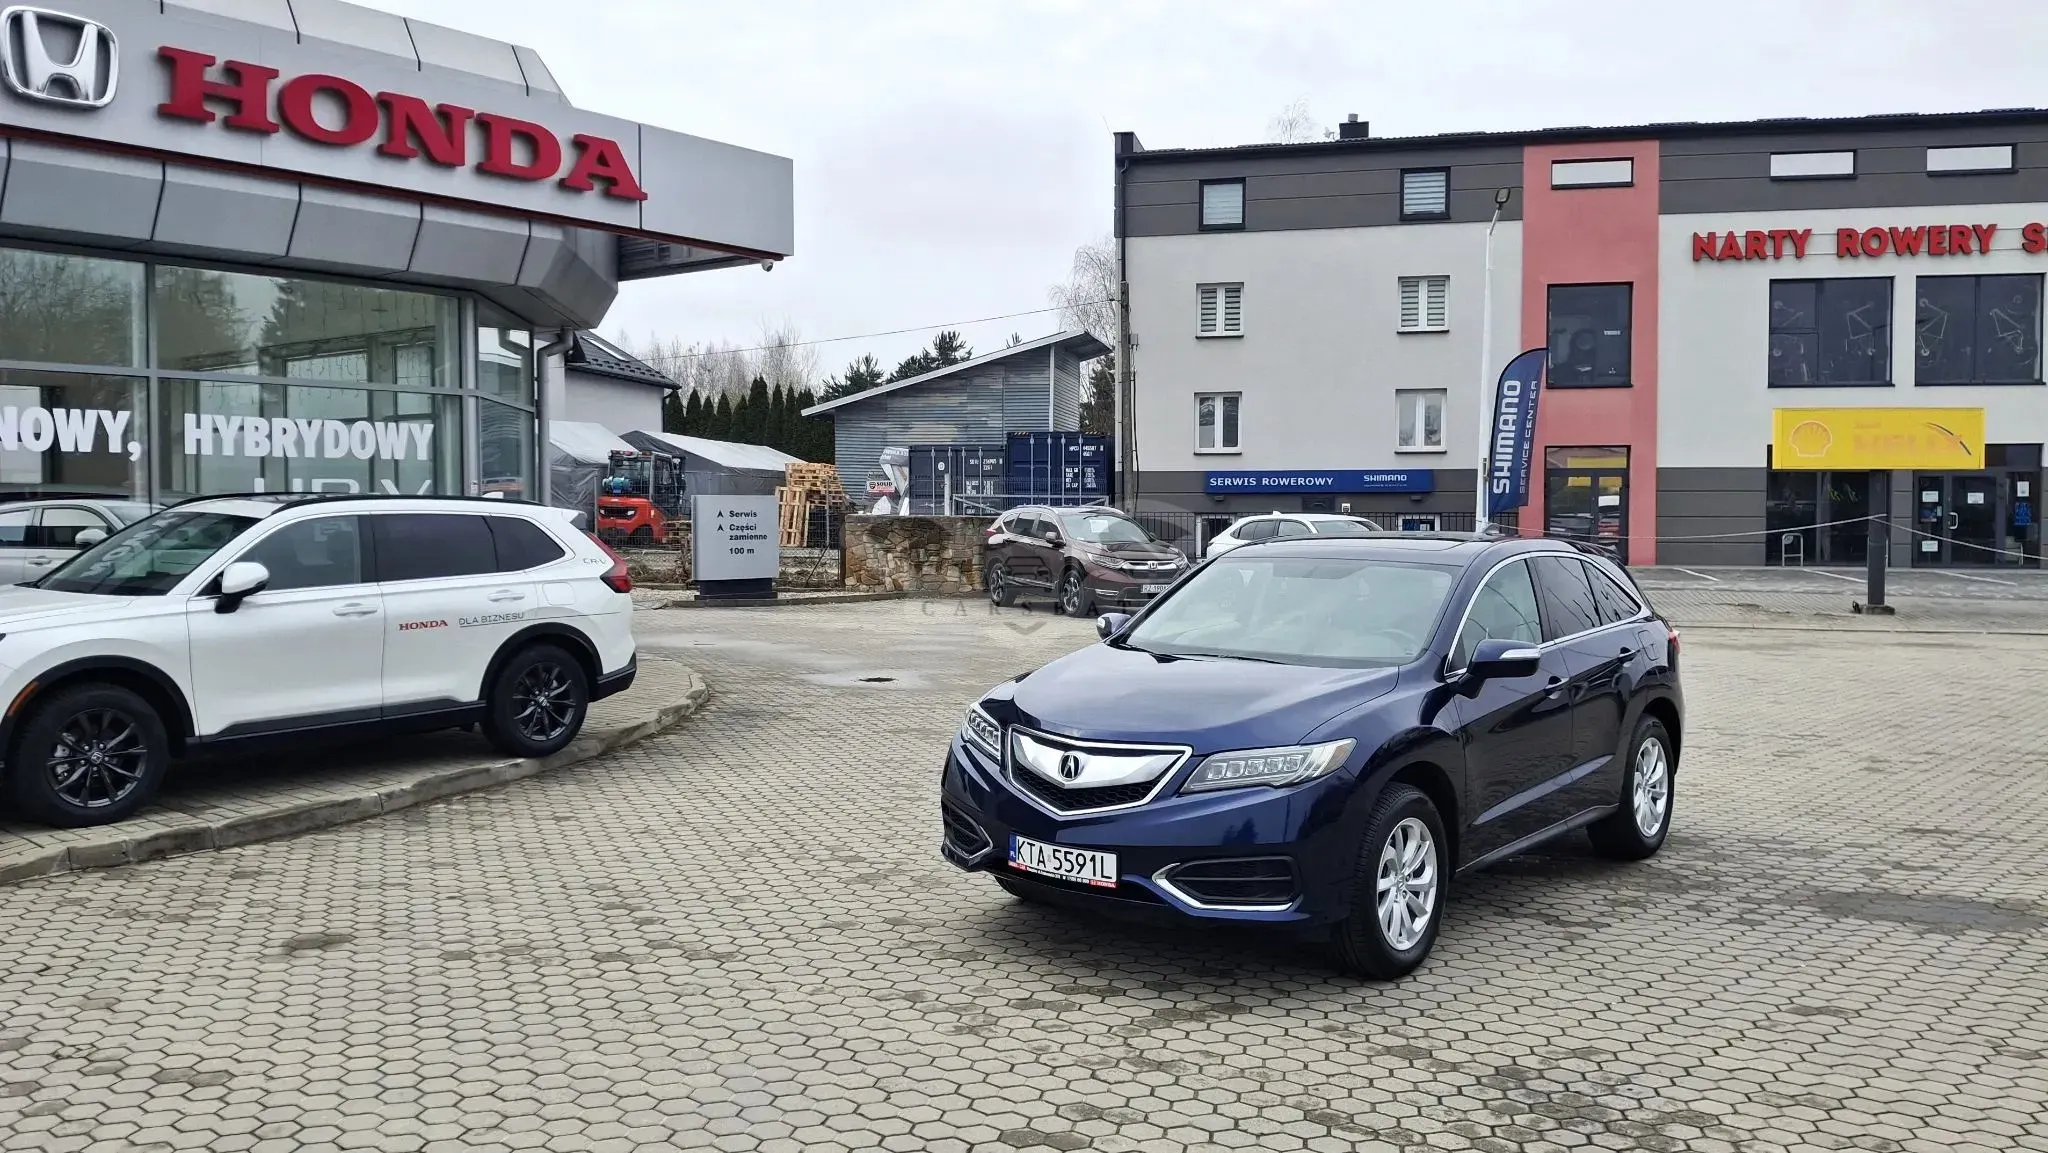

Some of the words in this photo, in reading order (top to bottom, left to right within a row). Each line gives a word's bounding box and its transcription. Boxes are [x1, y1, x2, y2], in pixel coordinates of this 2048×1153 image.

[157, 46, 648, 201] HONDA
[1693, 228, 1812, 261] NARTY
[1836, 223, 1998, 258] ROWERY
[2021, 222, 2048, 254] S
[184, 413, 435, 461] HYBRYDOWY
[1493, 380, 1521, 494] SHIMANO
[1520, 443, 1530, 494] SERVICE
[1525, 380, 1538, 440] CENTER
[1210, 477, 1257, 486] SERWIS
[1262, 477, 1334, 486] ROWEROWY
[1363, 474, 1407, 482] SHIMANO
[729, 510, 758, 518] Serwis
[729, 523, 757, 533] Części
[729, 533, 768, 541] zamienne
[729, 547, 745, 555] 100
[399, 619, 448, 631] HONDA
[458, 616, 479, 626] DLA
[481, 611, 525, 624] BIZNESU
[1017, 838, 1047, 869] KTA
[1052, 848, 1113, 880] 5591L
